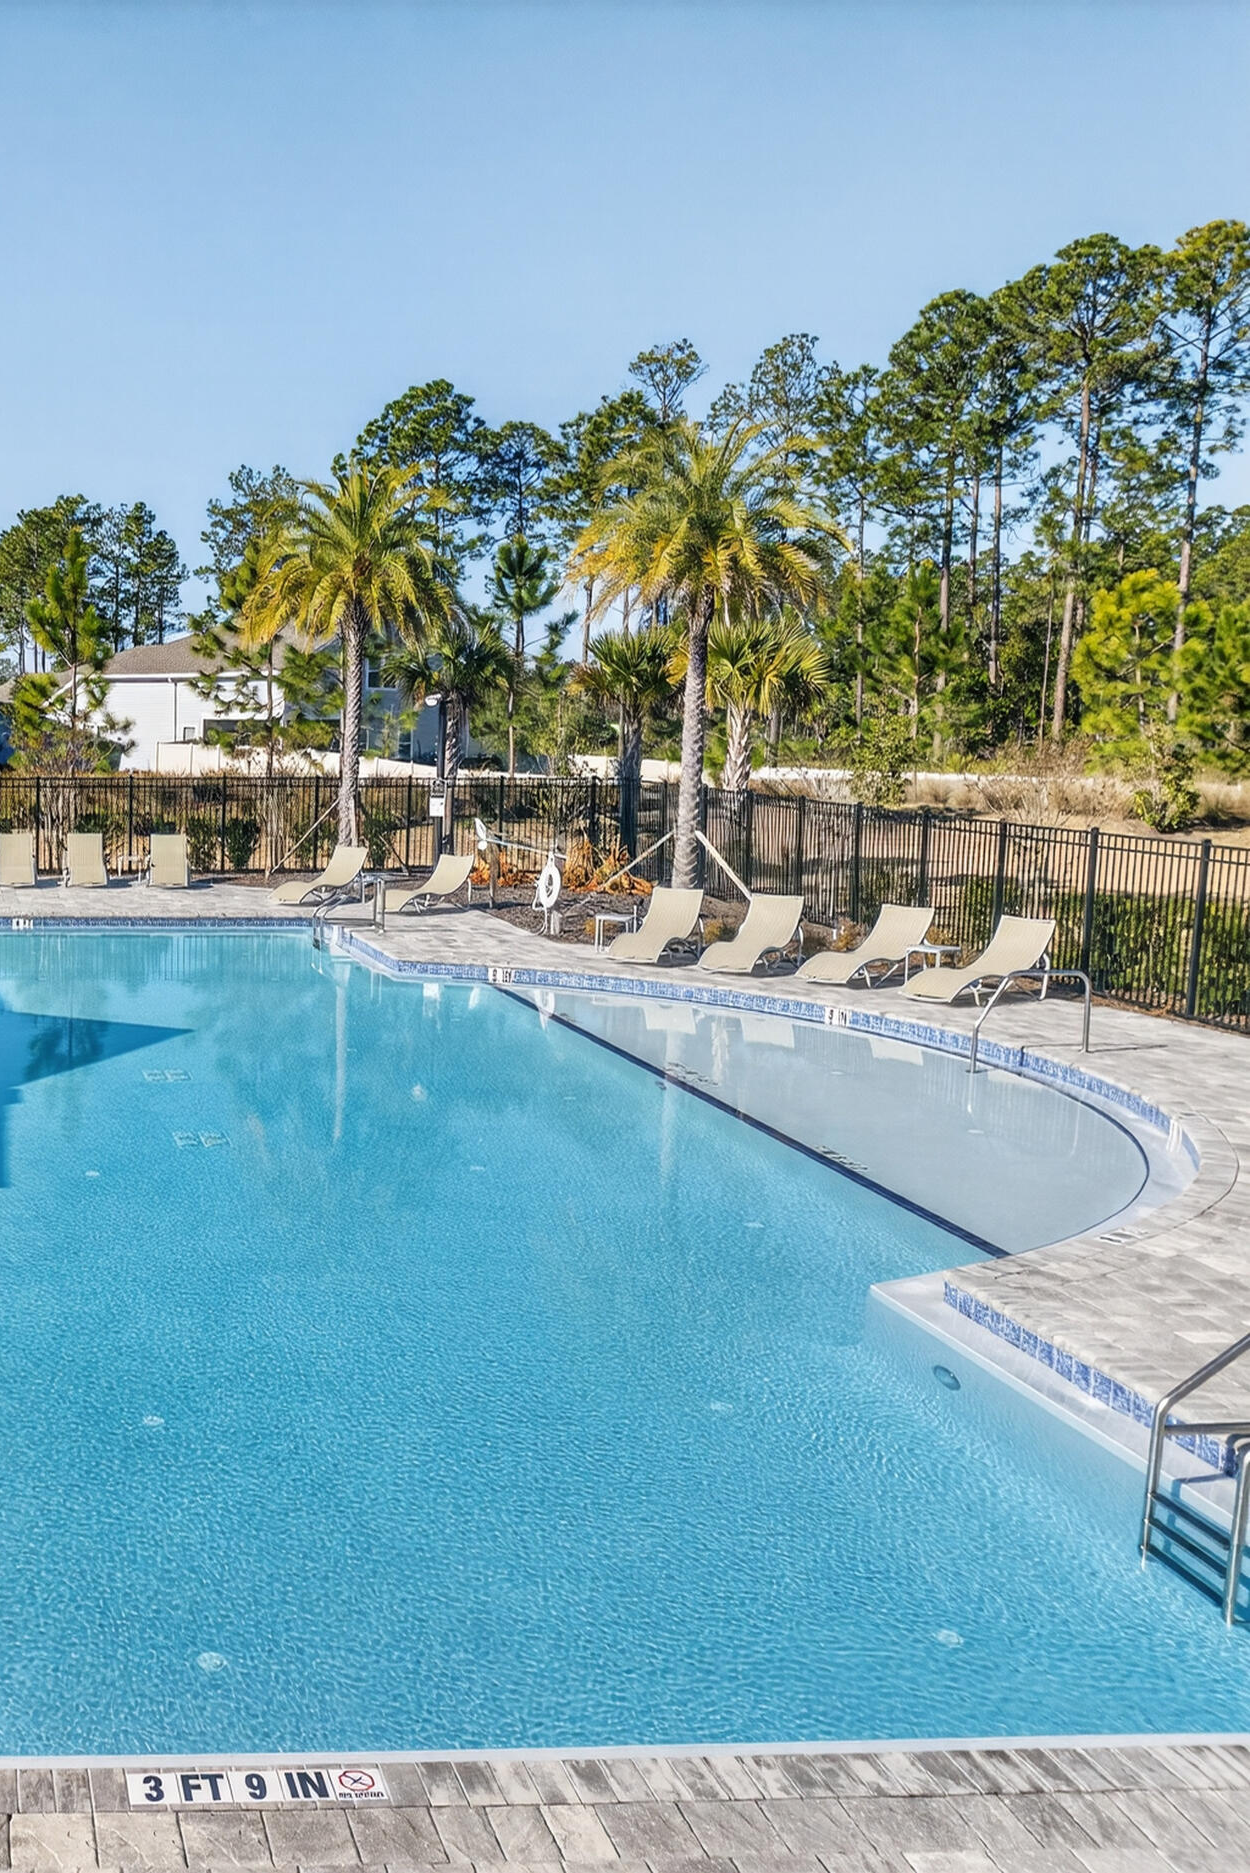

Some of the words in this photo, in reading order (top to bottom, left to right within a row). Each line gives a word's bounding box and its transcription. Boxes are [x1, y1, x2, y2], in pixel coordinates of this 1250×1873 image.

[143, 1775, 165, 1802] 3
[180, 1774, 225, 1801] FT
[245, 1773, 267, 1800] 9
[284, 1772, 330, 1799] IN
